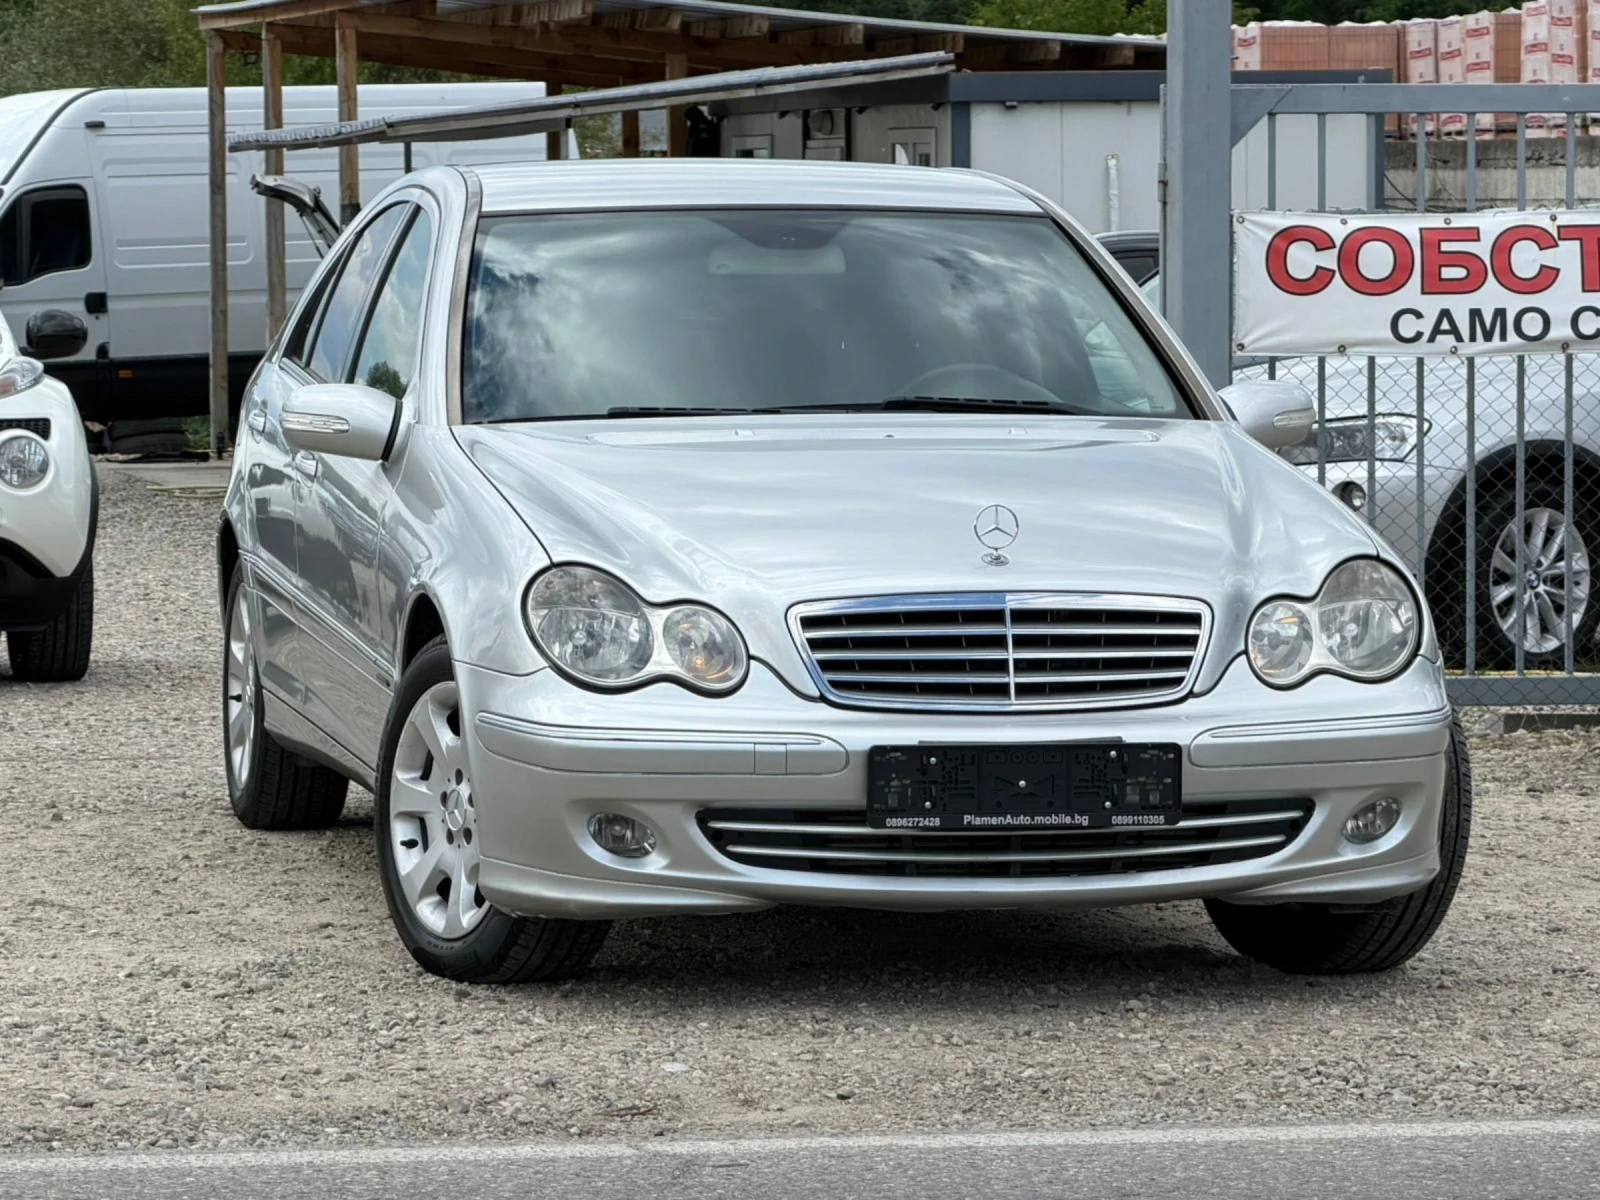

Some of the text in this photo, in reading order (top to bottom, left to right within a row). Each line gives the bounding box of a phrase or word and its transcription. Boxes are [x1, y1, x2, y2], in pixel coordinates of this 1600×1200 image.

[1265, 225, 1600, 296] СОБСТ
[1390, 306, 1551, 343] САМО
[885, 814, 1165, 827] 0896272428 PlamenAuto.mobile.bg 0899110305
